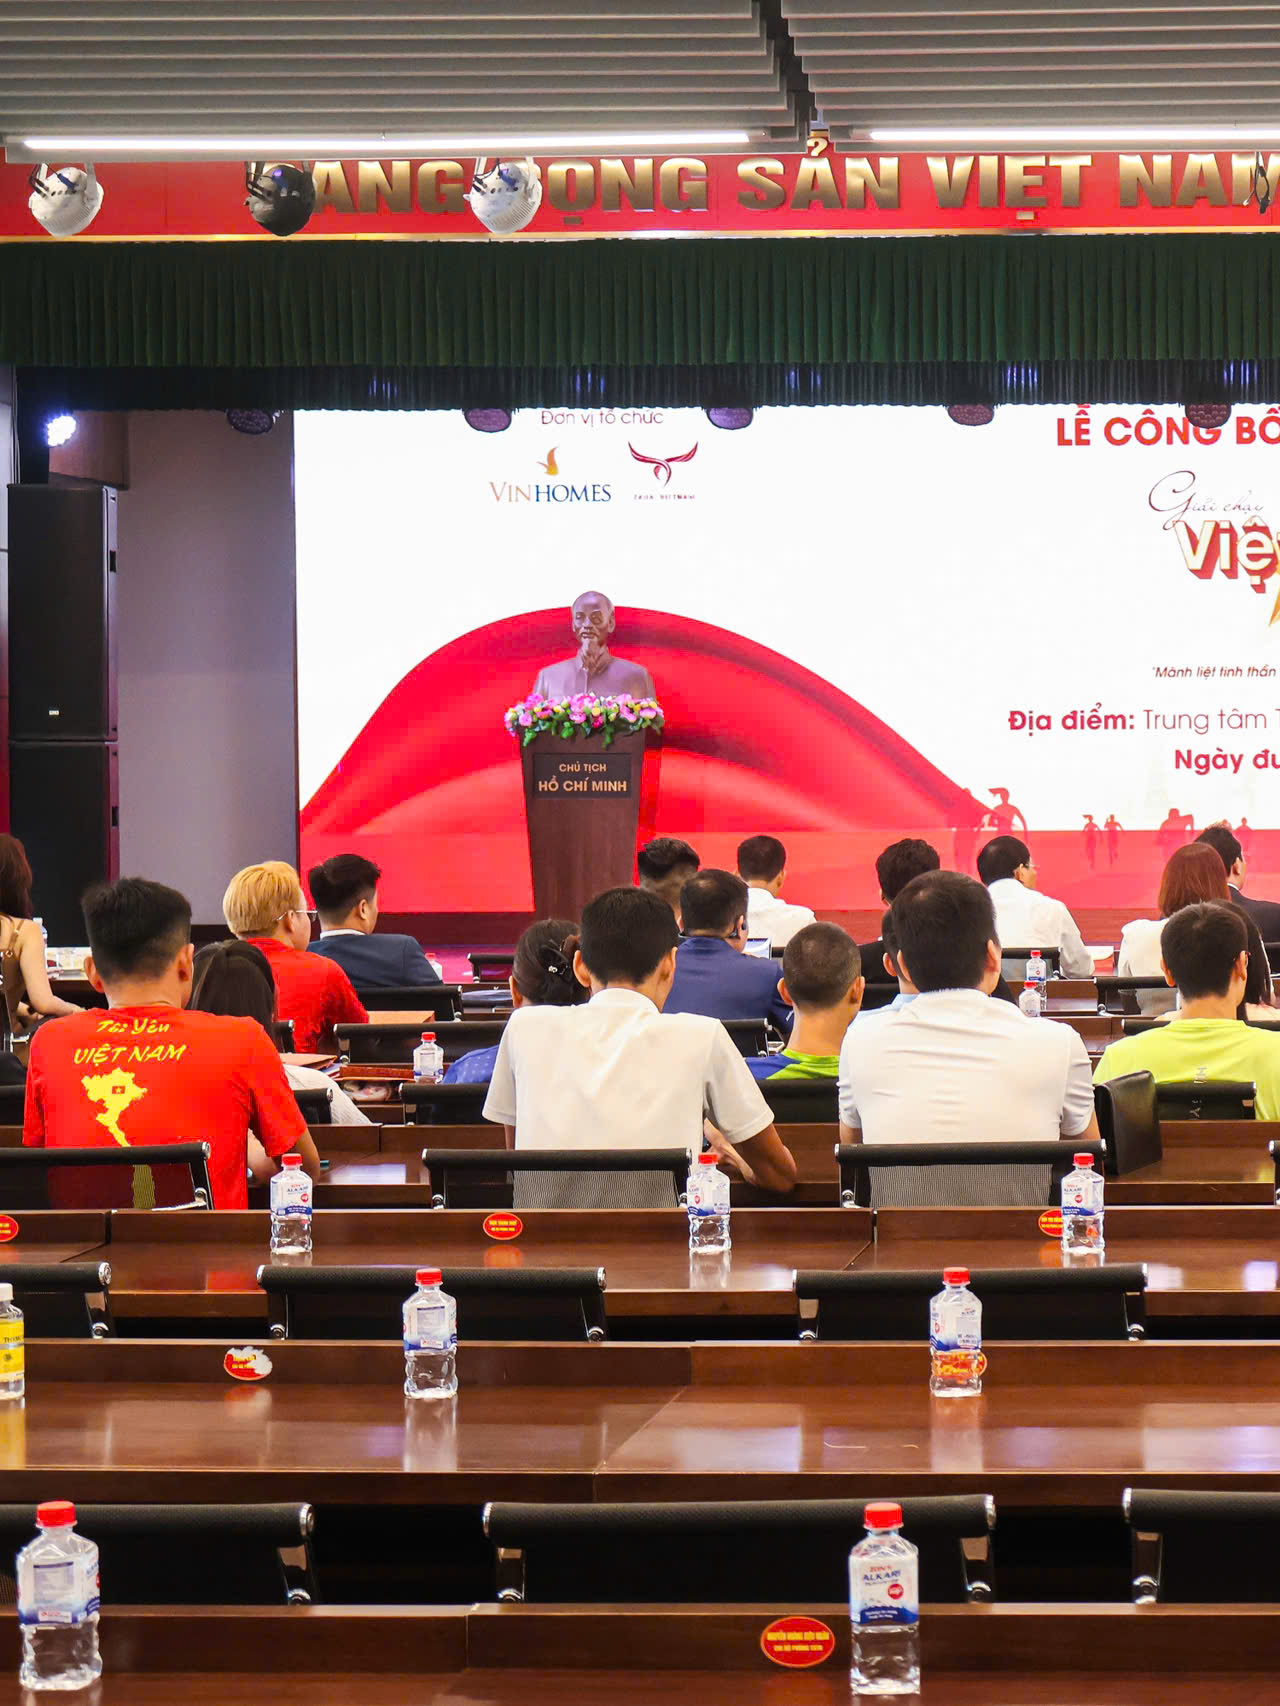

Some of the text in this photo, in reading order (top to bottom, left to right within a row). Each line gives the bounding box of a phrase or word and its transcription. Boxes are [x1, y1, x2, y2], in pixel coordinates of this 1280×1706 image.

[736, 138, 901, 211] SẢN
[541, 410, 576, 425] Đơn
[581, 410, 594, 428] vị
[620, 411, 665, 425] chức
[1104, 408, 1222, 446] CÔNG
[489, 482, 612, 502] VINHOMES
[1008, 710, 1052, 737] Địa
[1061, 702, 1135, 730] điểm:
[1143, 708, 1209, 735] Trung
[1217, 708, 1267, 730] tâm
[559, 761, 607, 774] CHỦ TỊCH
[1174, 747, 1244, 775] Ngày
[563, 777, 588, 792] CHÍ
[591, 780, 627, 792] MINH
[128, 1044, 186, 1062] NAM
